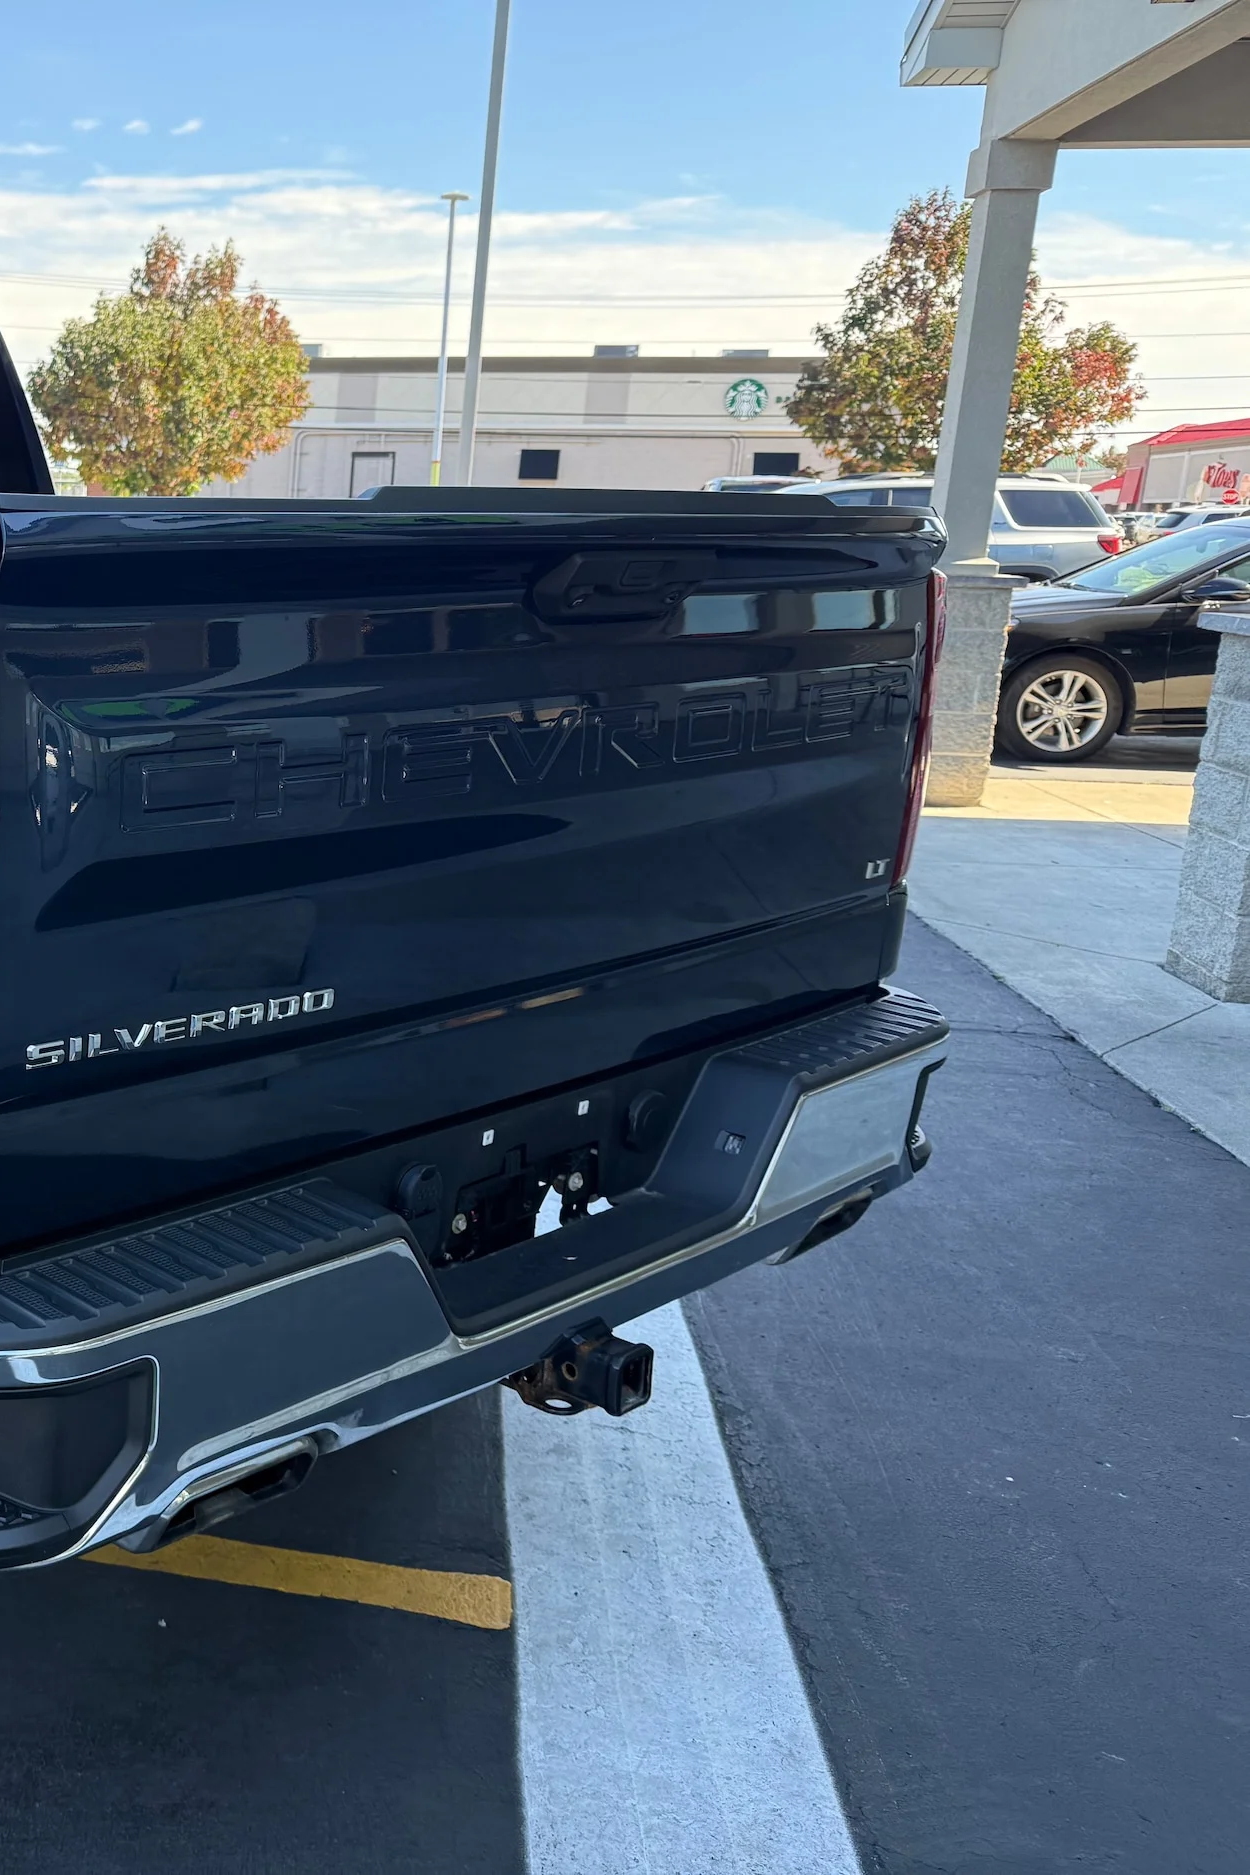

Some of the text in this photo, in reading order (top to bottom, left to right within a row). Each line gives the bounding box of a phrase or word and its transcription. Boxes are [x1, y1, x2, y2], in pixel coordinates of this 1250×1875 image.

[119, 671, 908, 833] CHEVROLET
[865, 858, 891, 879] LT
[25, 988, 335, 1070] SILVERADO
